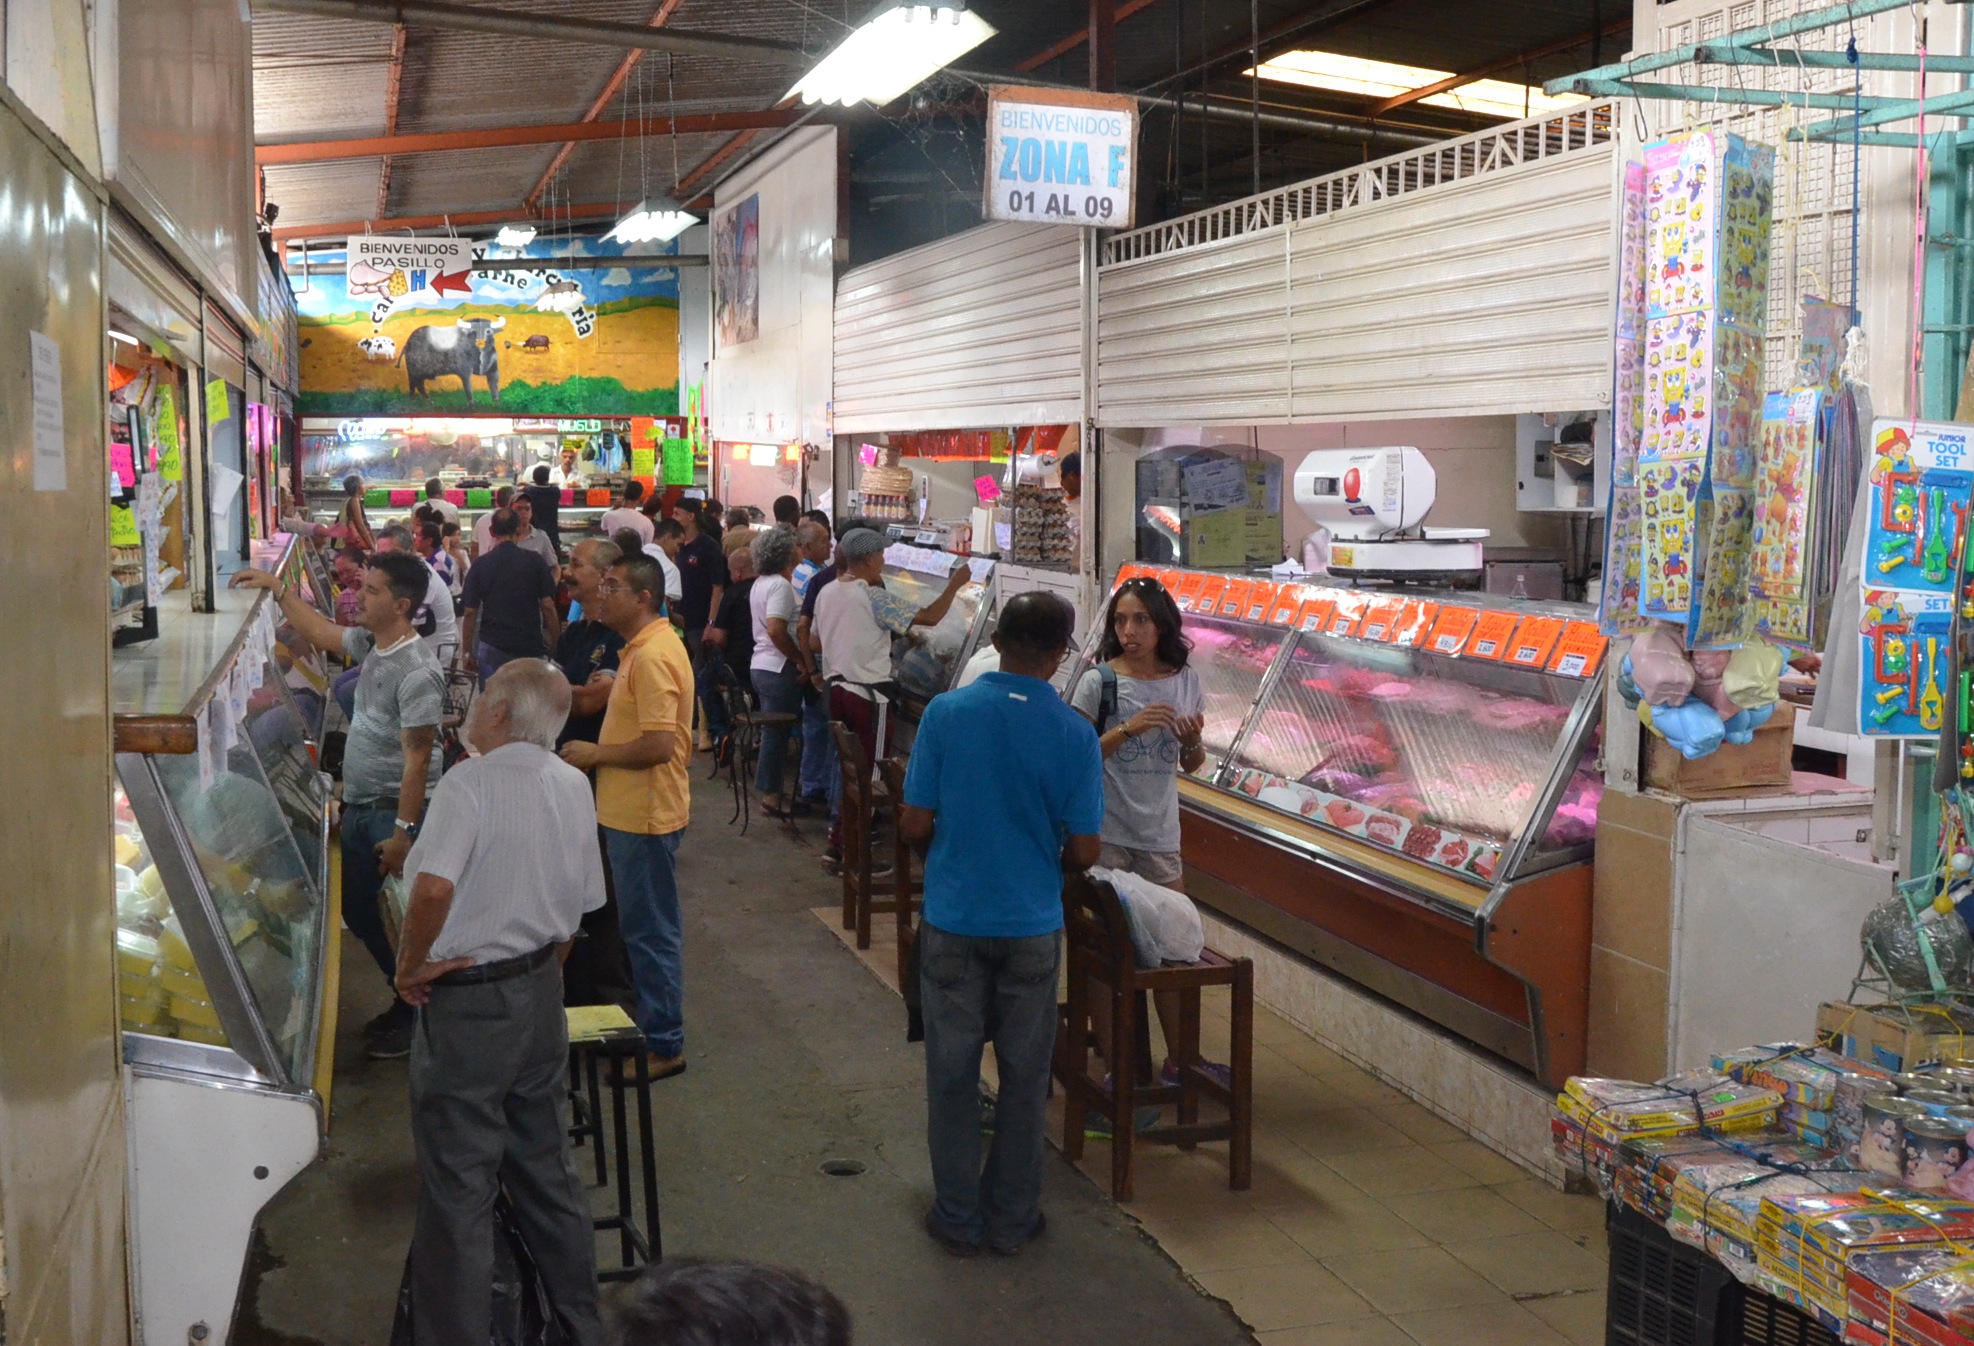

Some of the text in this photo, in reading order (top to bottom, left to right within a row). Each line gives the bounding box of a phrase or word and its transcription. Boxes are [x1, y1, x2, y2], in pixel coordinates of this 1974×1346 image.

[1001, 110, 1122, 137] BIENVENIDOS
[999, 136, 1127, 188] ZONA F
[1009, 190, 1113, 219] 01 AL 09
[360, 243, 459, 255] BIENVENIDOS
[371, 257, 445, 269] PASILLO
[411, 269, 426, 292] H
[1938, 433, 1966, 443] JUNIOR
[1927, 441, 1967, 456] TOOL
[1935, 454, 1959, 468] SET
[1925, 598, 1949, 611] SET
